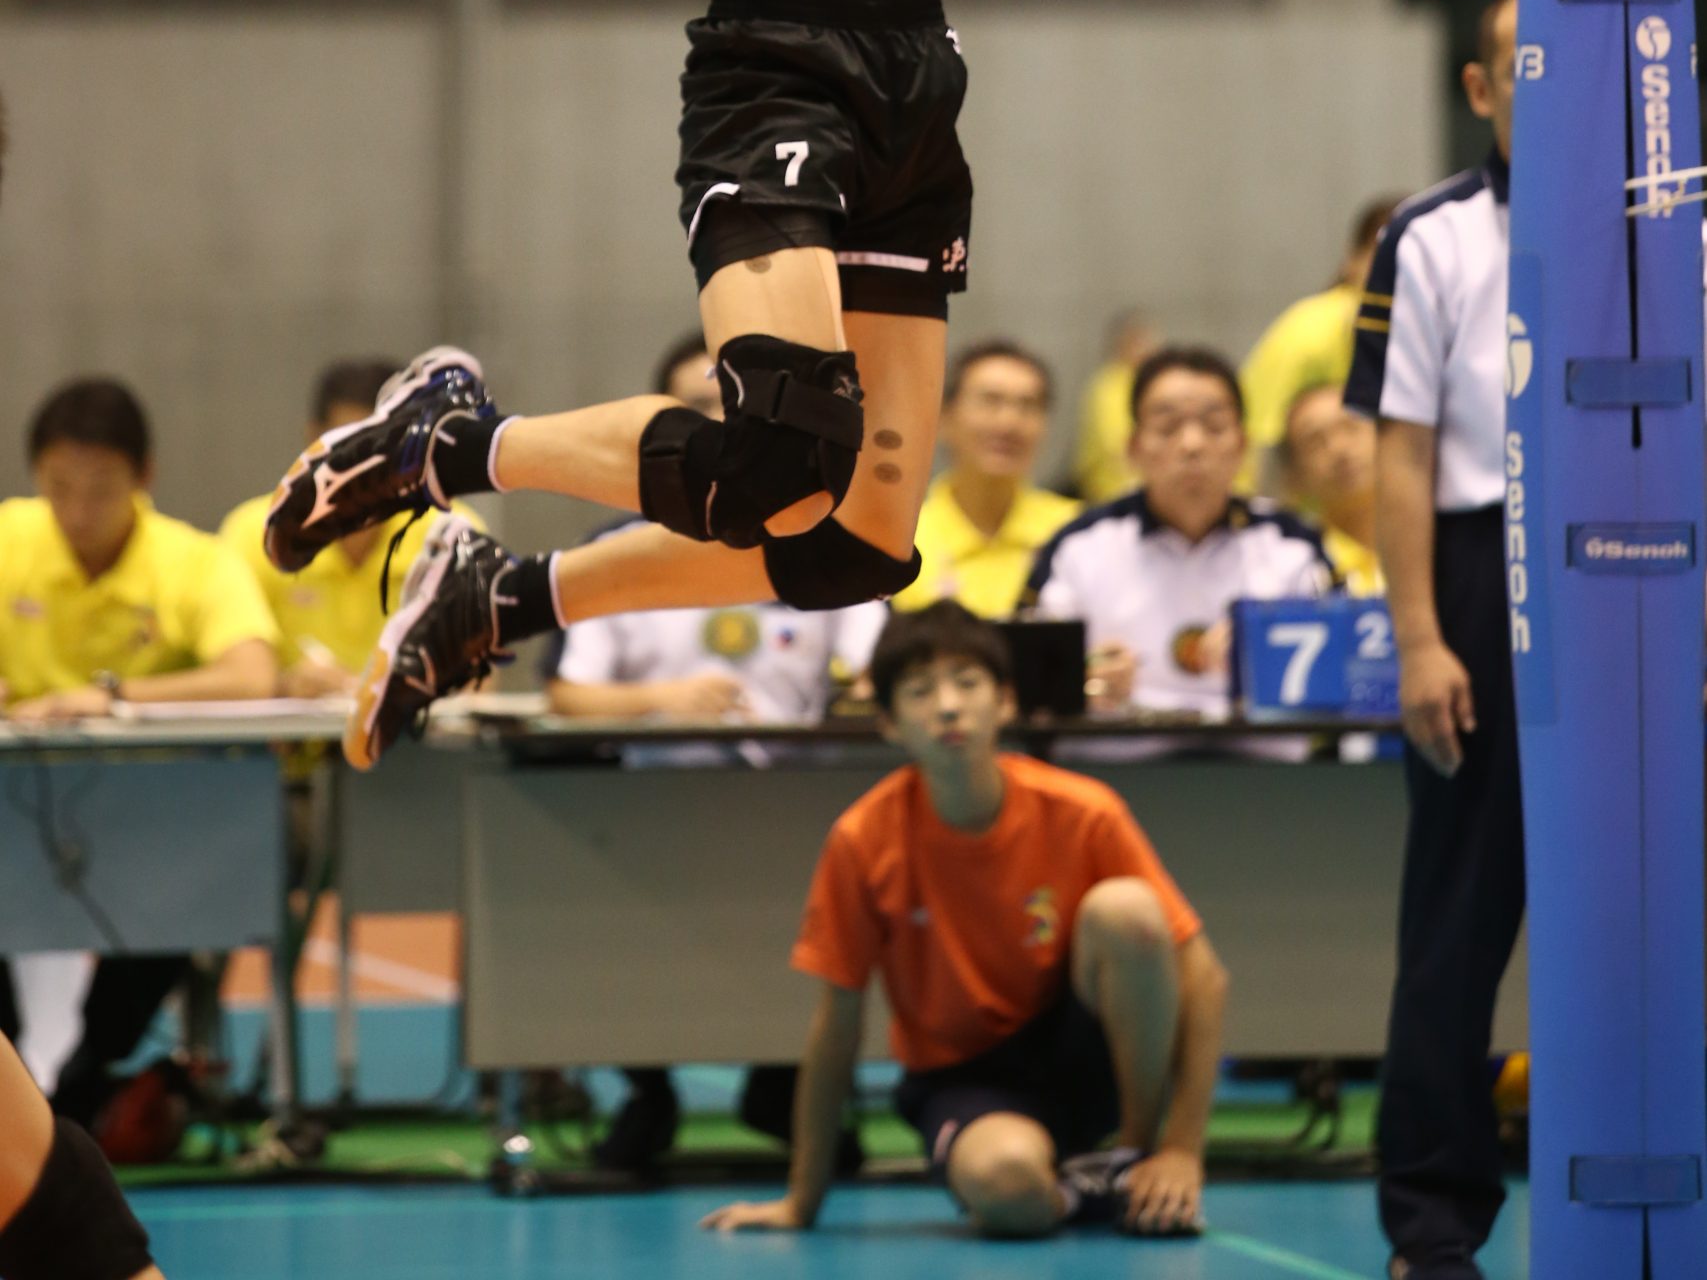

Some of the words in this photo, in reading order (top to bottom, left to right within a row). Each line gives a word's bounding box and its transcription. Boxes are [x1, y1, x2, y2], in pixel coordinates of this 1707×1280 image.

[775, 140, 809, 187] 7
[1505, 431, 1531, 654] Senoh
[1266, 621, 1330, 706] 7
[1354, 610, 1394, 660] 2
